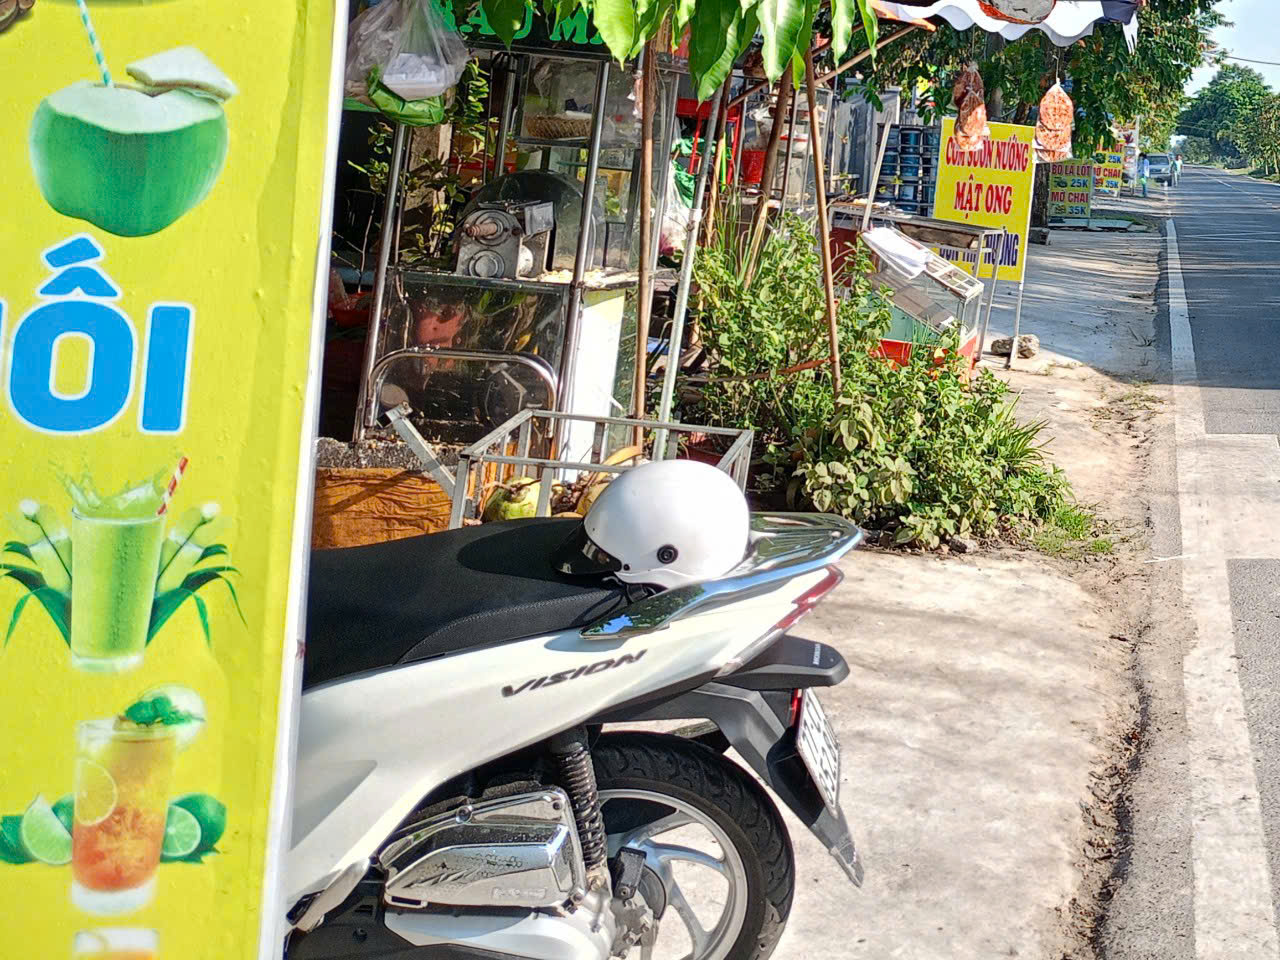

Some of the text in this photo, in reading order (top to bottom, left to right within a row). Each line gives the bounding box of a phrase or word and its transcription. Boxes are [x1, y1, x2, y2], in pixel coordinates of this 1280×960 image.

[993, 134, 1030, 172] NƯỚNG
[954, 174, 1012, 219] MẬT ONG
[1070, 178, 1089, 188] 25K
[0, 232, 196, 436] ỐI
[501, 648, 648, 698] VISION
